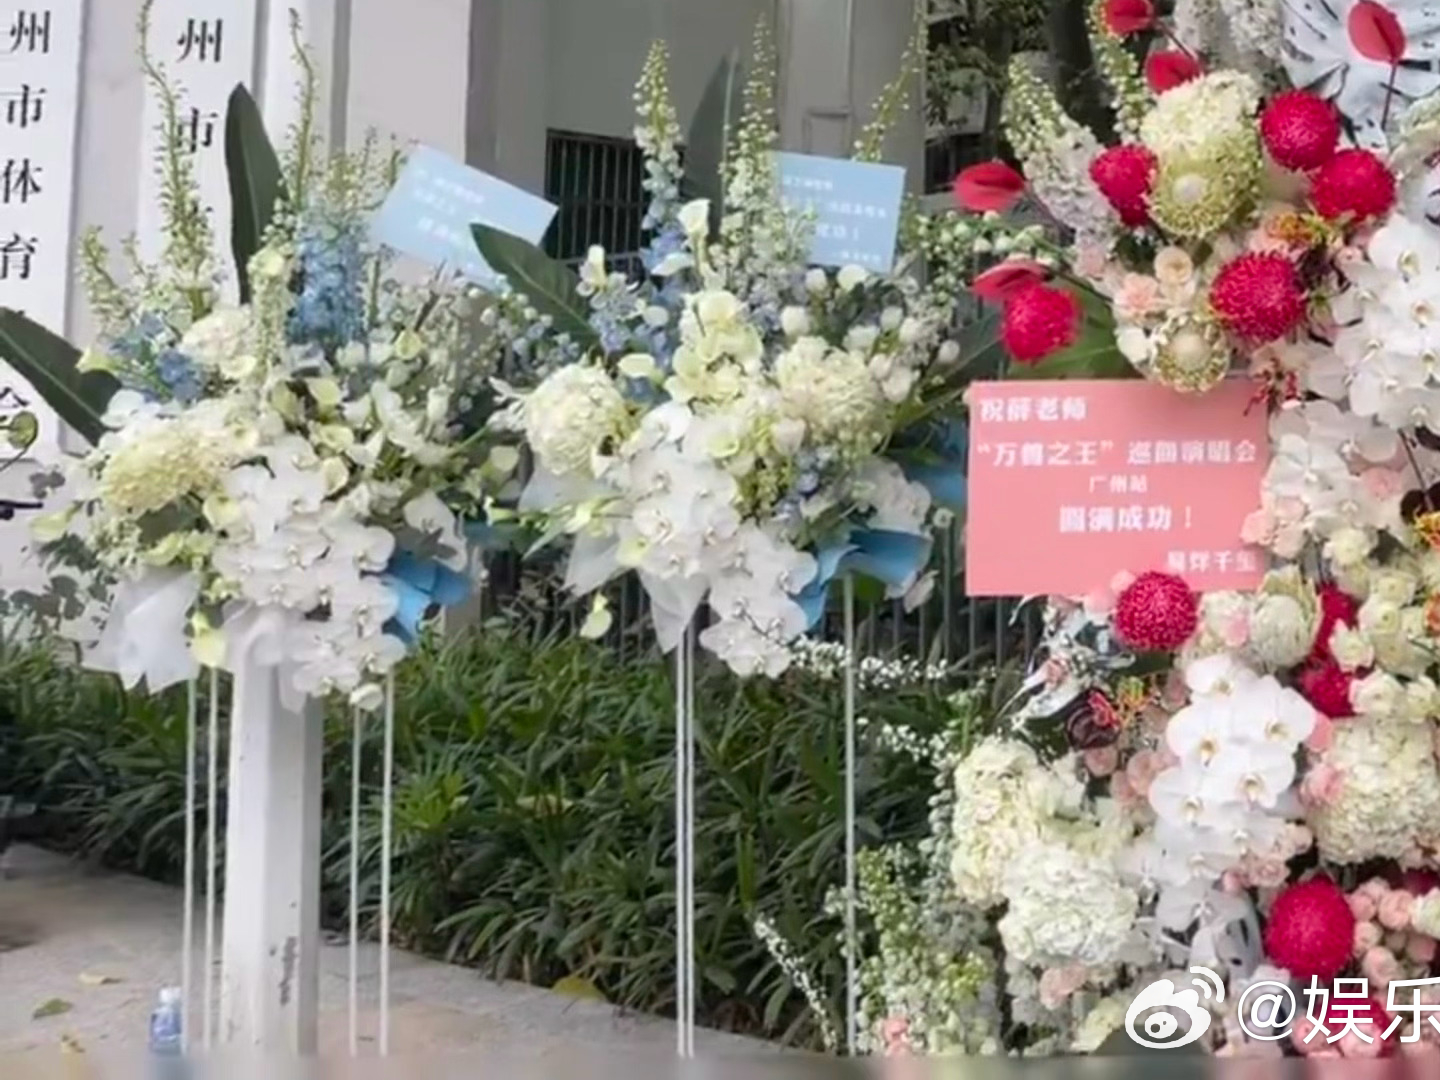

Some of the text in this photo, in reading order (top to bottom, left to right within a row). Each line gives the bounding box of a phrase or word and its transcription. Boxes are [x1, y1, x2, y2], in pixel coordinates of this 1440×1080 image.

[980, 397, 1087, 422] 祝薛老师
[1088, 474, 1148, 494] 广州站
